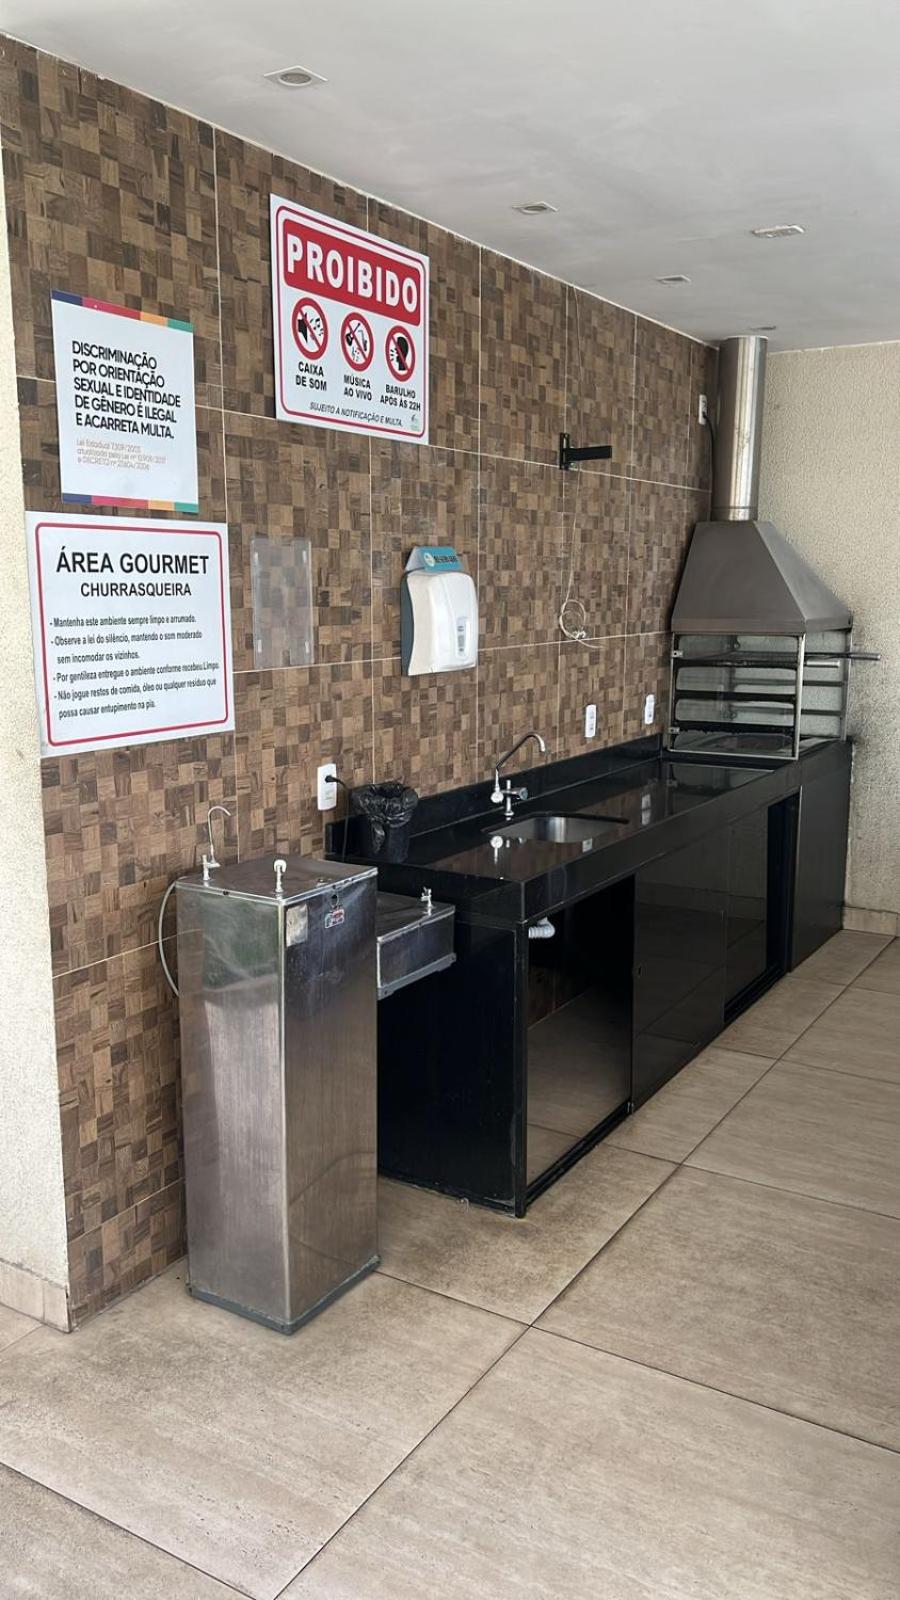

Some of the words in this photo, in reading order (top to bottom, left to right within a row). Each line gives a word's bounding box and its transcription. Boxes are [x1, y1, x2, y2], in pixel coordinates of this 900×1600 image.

[286, 233, 418, 313] PROIBIDO
[72, 340, 157, 370] DISCRIMINAÇÃO
[73, 358, 97, 376] POR
[98, 364, 165, 388] ORIENTAÇÃO
[298, 361, 324, 377] CAIXA
[295, 374, 307, 387] DE
[309, 378, 327, 391] SOM
[343, 374, 371, 389] MÚSICA
[385, 384, 416, 399] BARULHO
[74, 377, 114, 396] SEXUAL
[115, 384, 122, 397] E
[123, 385, 181, 407] IDENTIDADE
[343, 387, 354, 397] AO
[356, 389, 373, 401] VIVO
[75, 394, 90, 409] DE
[91, 395, 136, 416] GÊNERO
[137, 401, 144, 417] É
[144, 405, 177, 423] ILEGAL
[310, 402, 335, 414] SUJEITO
[335, 406, 341, 415] A
[341, 406, 380, 422] NOTIFICAÇÃO
[380, 395, 398, 407] APÓS
[409, 400, 421, 412] 22H
[75, 412, 83, 426] E
[84, 414, 140, 434] ACARRETA
[141, 422, 175, 439] MULTA.
[56, 546, 114, 573] ÁREA
[120, 553, 209, 574] GOURMET
[80, 582, 192, 597] CHURRASQUEIRA
[53, 616, 85, 628] Mantenha
[85, 617, 99, 626] este
[99, 616, 127, 626] ambiente
[127, 617, 149, 627] sempre
[149, 614, 165, 625] limpo
[170, 613, 197, 624] arrumado.
[54, 634, 82, 646] Observe
[87, 633, 96, 644] lei
[96, 633, 105, 644] do
[105, 632, 130, 643] silêncio,
[130, 631, 159, 642] mantendo
[164, 632, 176, 640] som
[176, 630, 203, 640] moderado
[57, 655, 71, 665] sem
[71, 652, 105, 663] incomodar
[105, 653, 114, 661] os
[114, 650, 140, 661] vizinhos.
[56, 672, 69, 683] Por
[69, 670, 97, 684] gentileza
[97, 669, 124, 680] entregue
[130, 665, 156, 677] ambiente
[156, 664, 181, 674] conforme
[57, 689, 71, 701] Não
[71, 688, 90, 702] jogue
[90, 687, 110, 698] restos
[110, 685, 118, 695] de
[118, 683, 142, 695] comida,
[142, 682, 155, 692] óleo
[155, 683, 164, 691] ou
[163, 679, 187, 692] qualquer
[206, 678, 217, 688] que
[58, 708, 79, 721] possa
[79, 705, 100, 717] causar
[100, 700, 138, 715] entupimento
[137, 702, 146, 710] na
